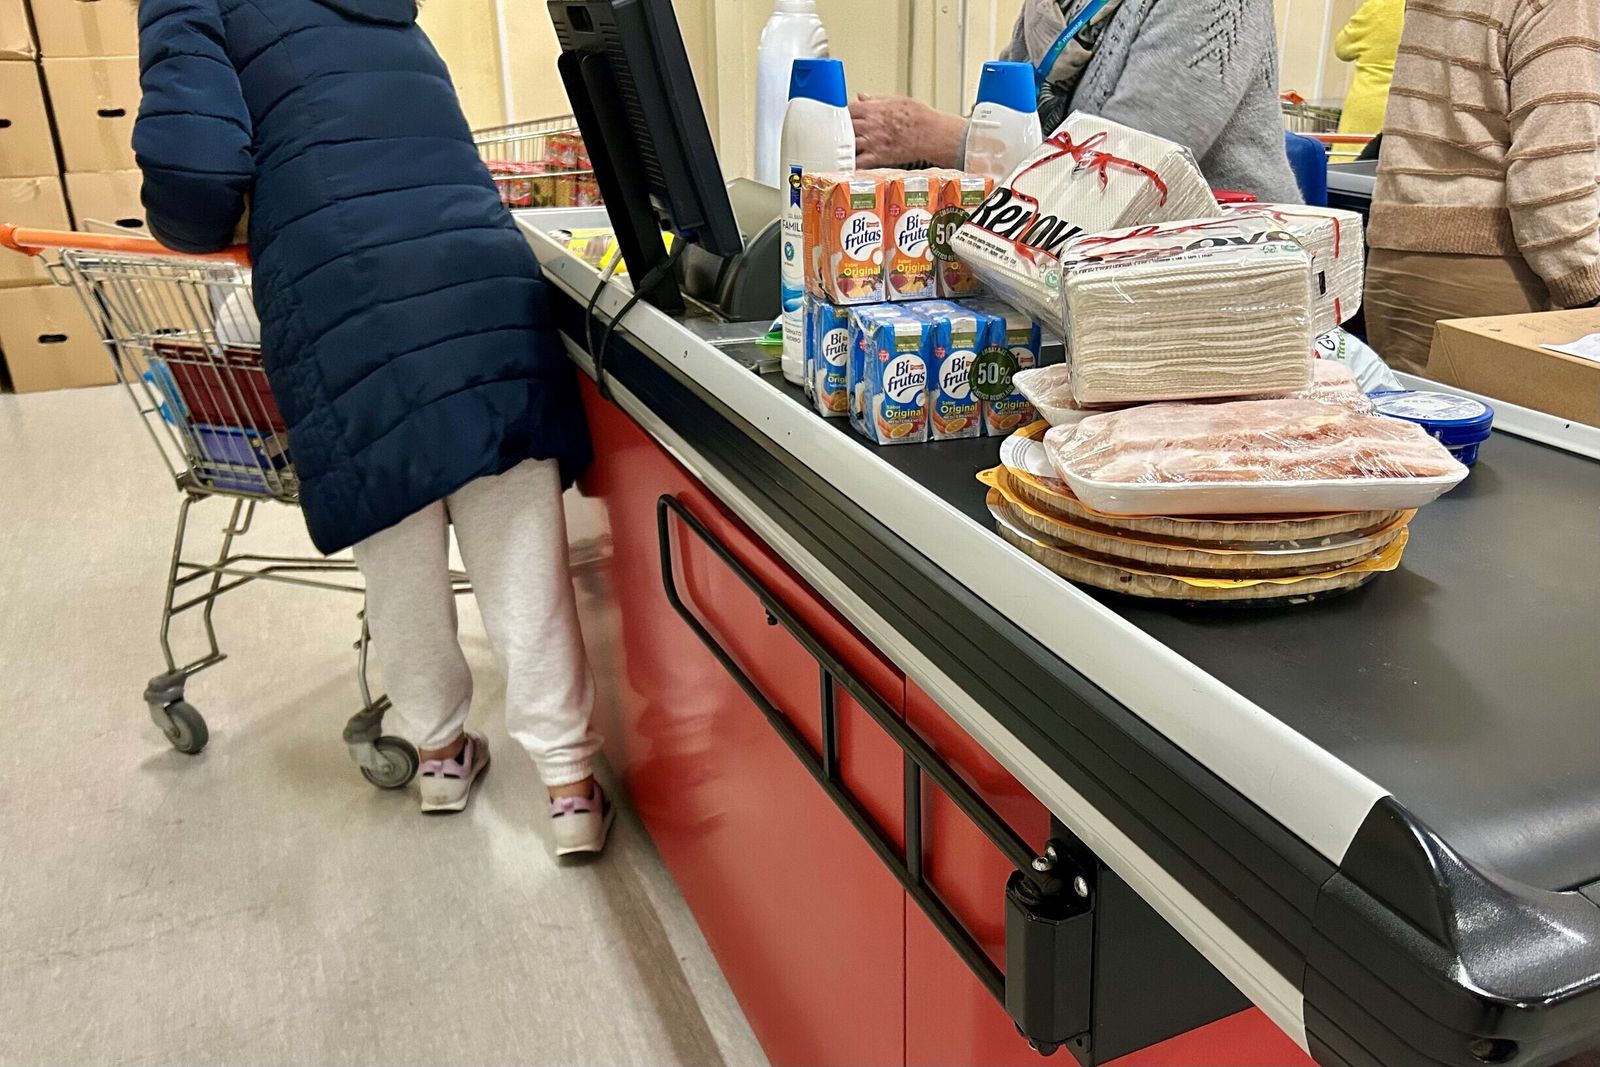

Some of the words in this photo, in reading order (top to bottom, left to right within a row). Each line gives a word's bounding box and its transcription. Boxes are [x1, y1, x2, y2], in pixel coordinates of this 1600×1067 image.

[853, 217, 865, 235] Bi
[907, 214, 919, 231] Bi
[845, 230, 881, 250] frutas
[899, 229, 928, 247] fruta
[844, 265, 880, 277] Original
[897, 263, 933, 274] Original
[831, 333, 842, 346] Bi
[896, 360, 909, 377] Bi
[952, 356, 965, 373] Bi
[888, 372, 925, 392] frutas
[977, 362, 1011, 385] 50%
[885, 408, 924, 419] Original
[941, 404, 978, 414] Original
